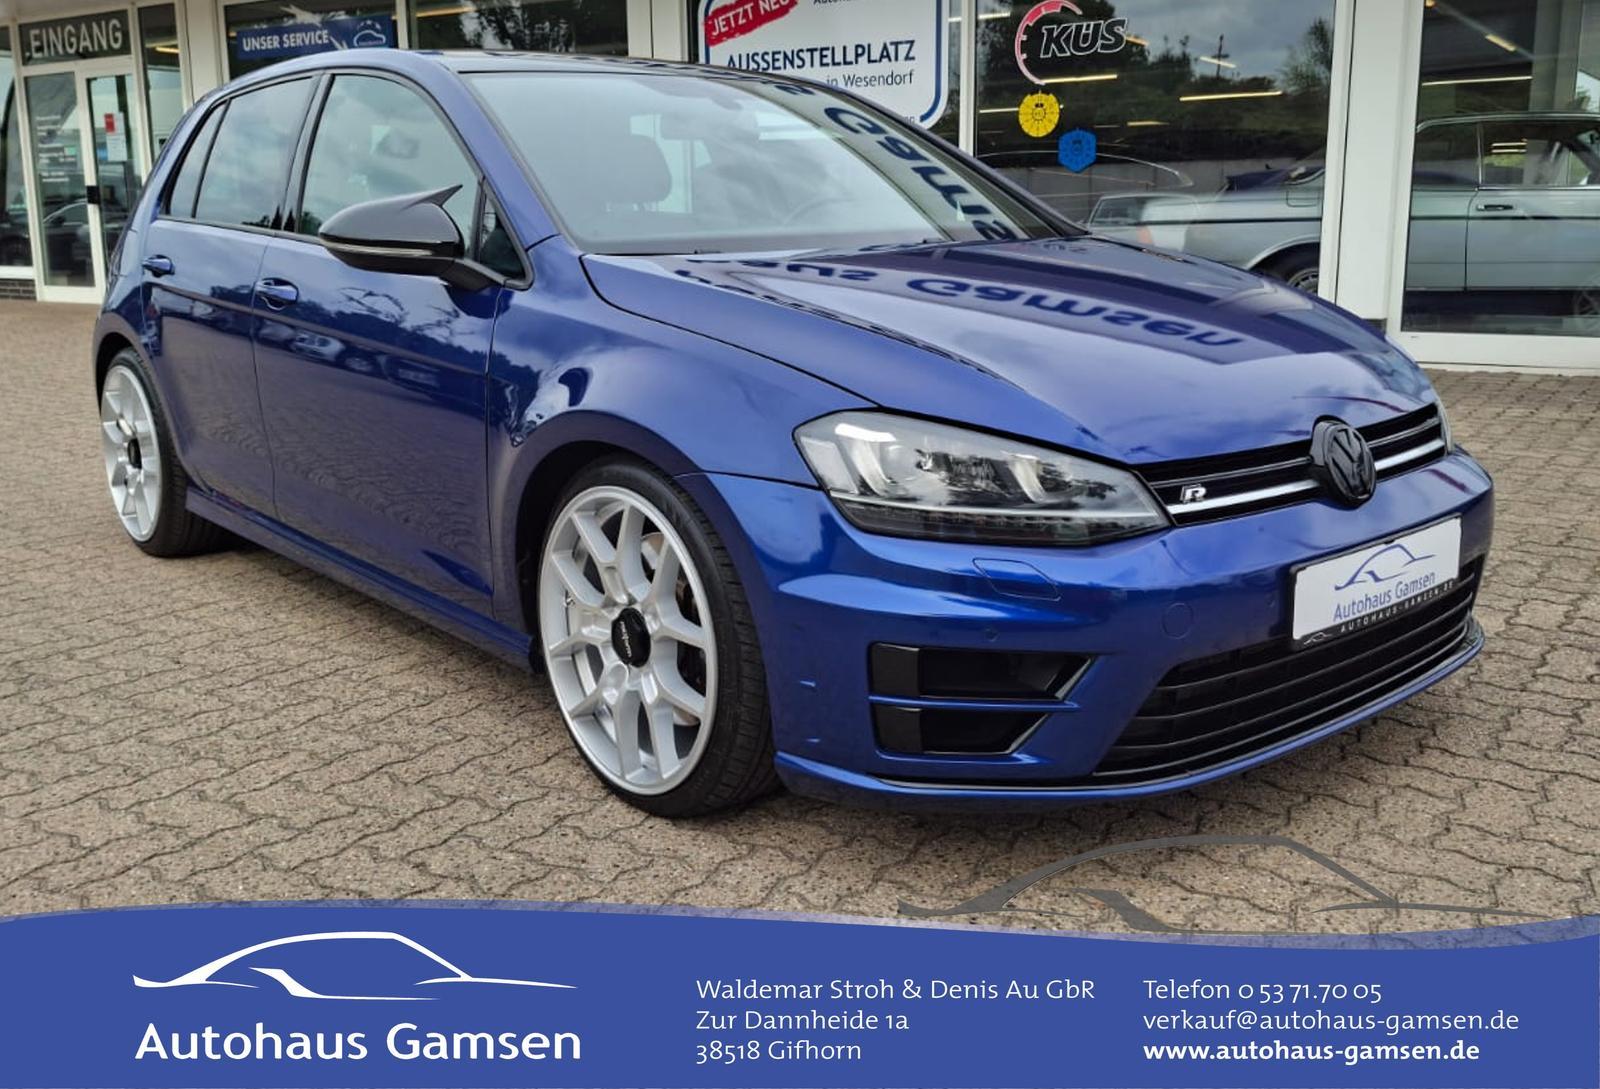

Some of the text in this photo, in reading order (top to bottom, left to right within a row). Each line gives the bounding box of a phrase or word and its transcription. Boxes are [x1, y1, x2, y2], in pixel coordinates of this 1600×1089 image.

[712, 3, 754, 36] JETZT
[29, 18, 122, 58] EINGANG
[242, 30, 329, 52] UNSER SERVICE
[1040, 18, 1128, 58] KÜS
[727, 40, 915, 71] AUSSENSTELLPLATZ
[842, 69, 914, 87] Wesendorf
[1180, 484, 1207, 502] R
[1333, 571, 1436, 623] Autohaus Gamsen
[1340, 580, 1454, 632] AUTOHAUS-GAMSEN.DE
